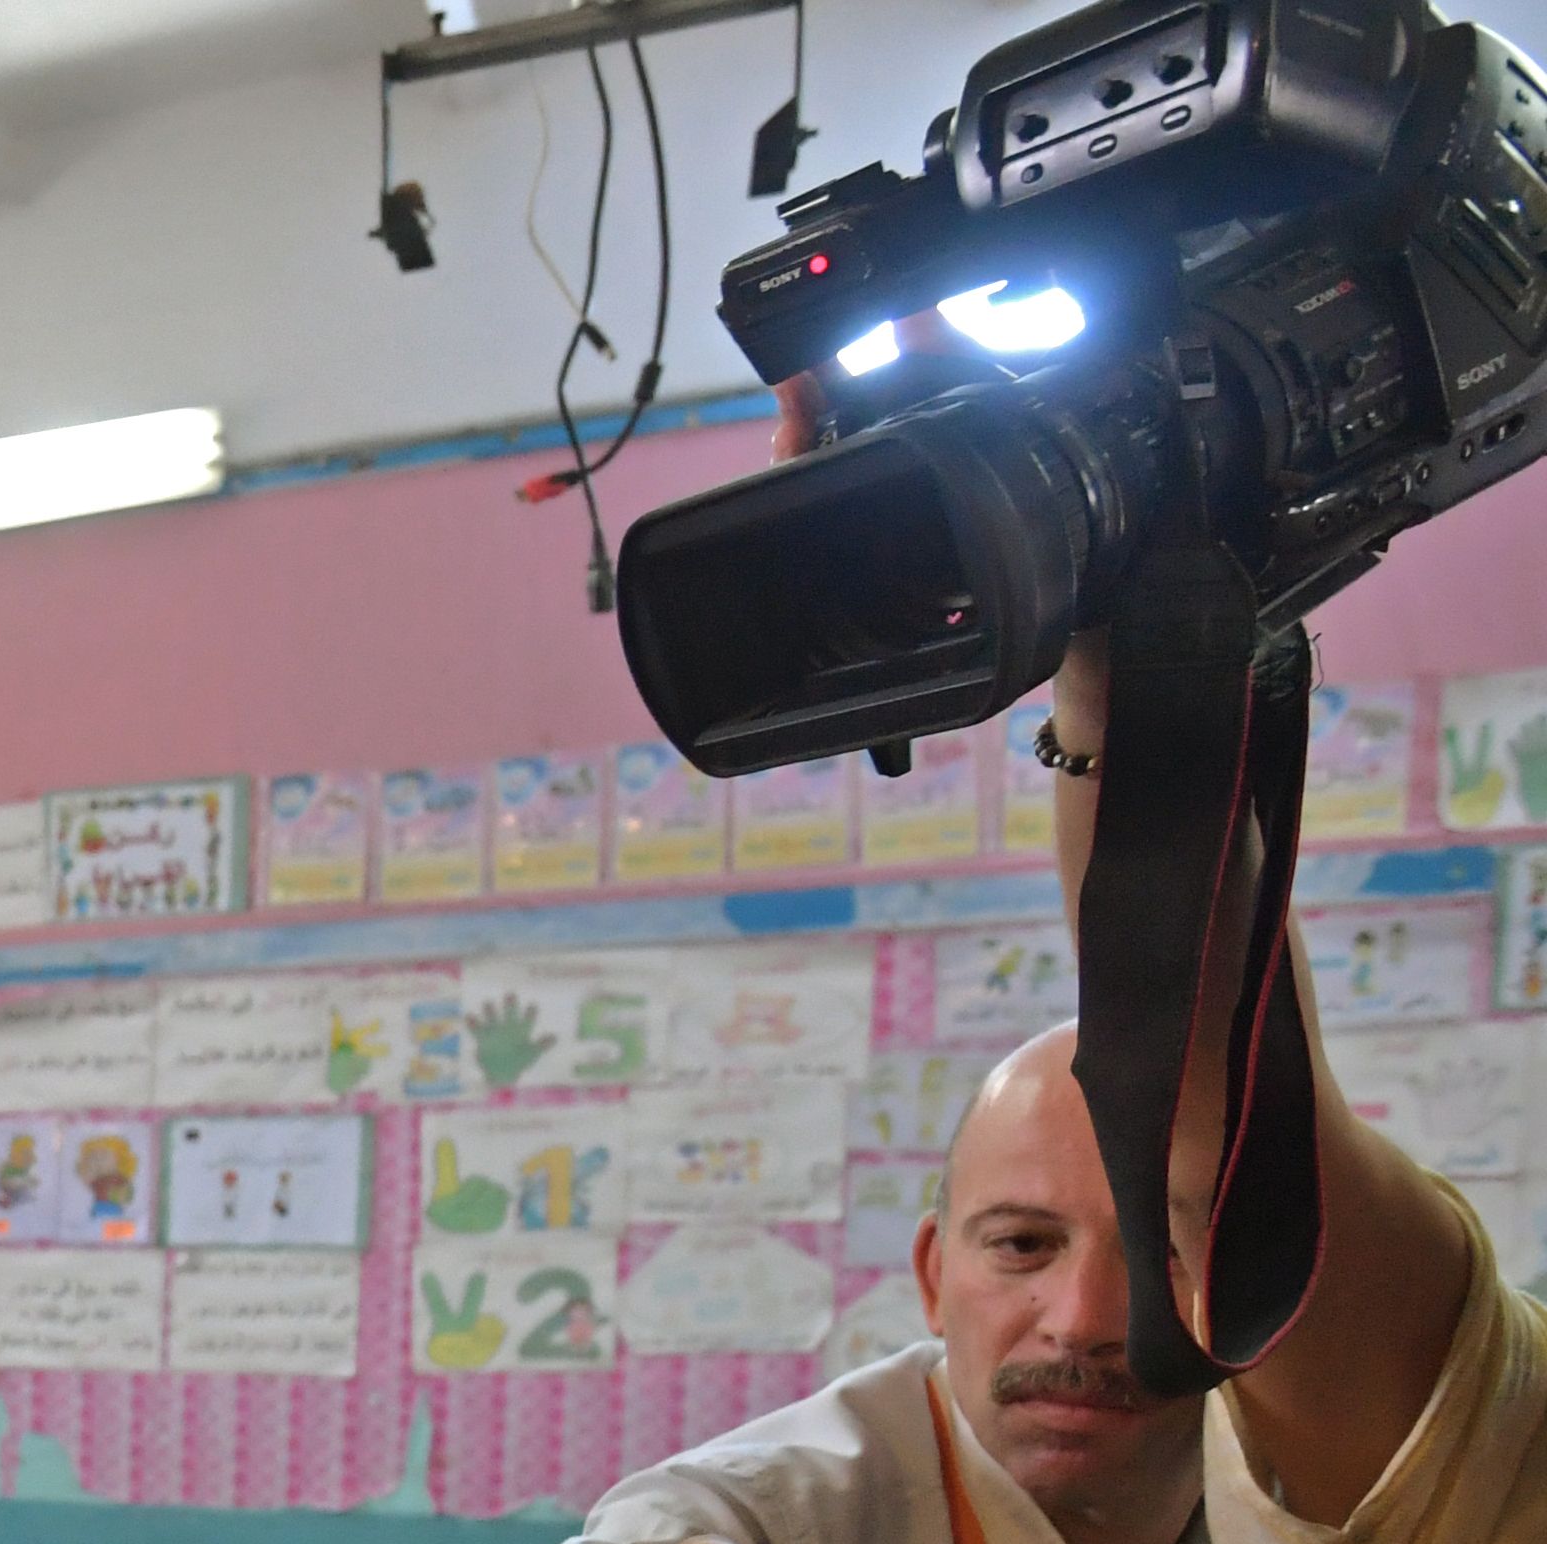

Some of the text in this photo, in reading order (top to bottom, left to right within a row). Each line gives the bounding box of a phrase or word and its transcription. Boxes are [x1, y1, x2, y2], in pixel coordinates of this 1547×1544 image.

[758, 267, 803, 293] SONY
[1457, 352, 1507, 391] SONY
[571, 993, 649, 1080] 5
